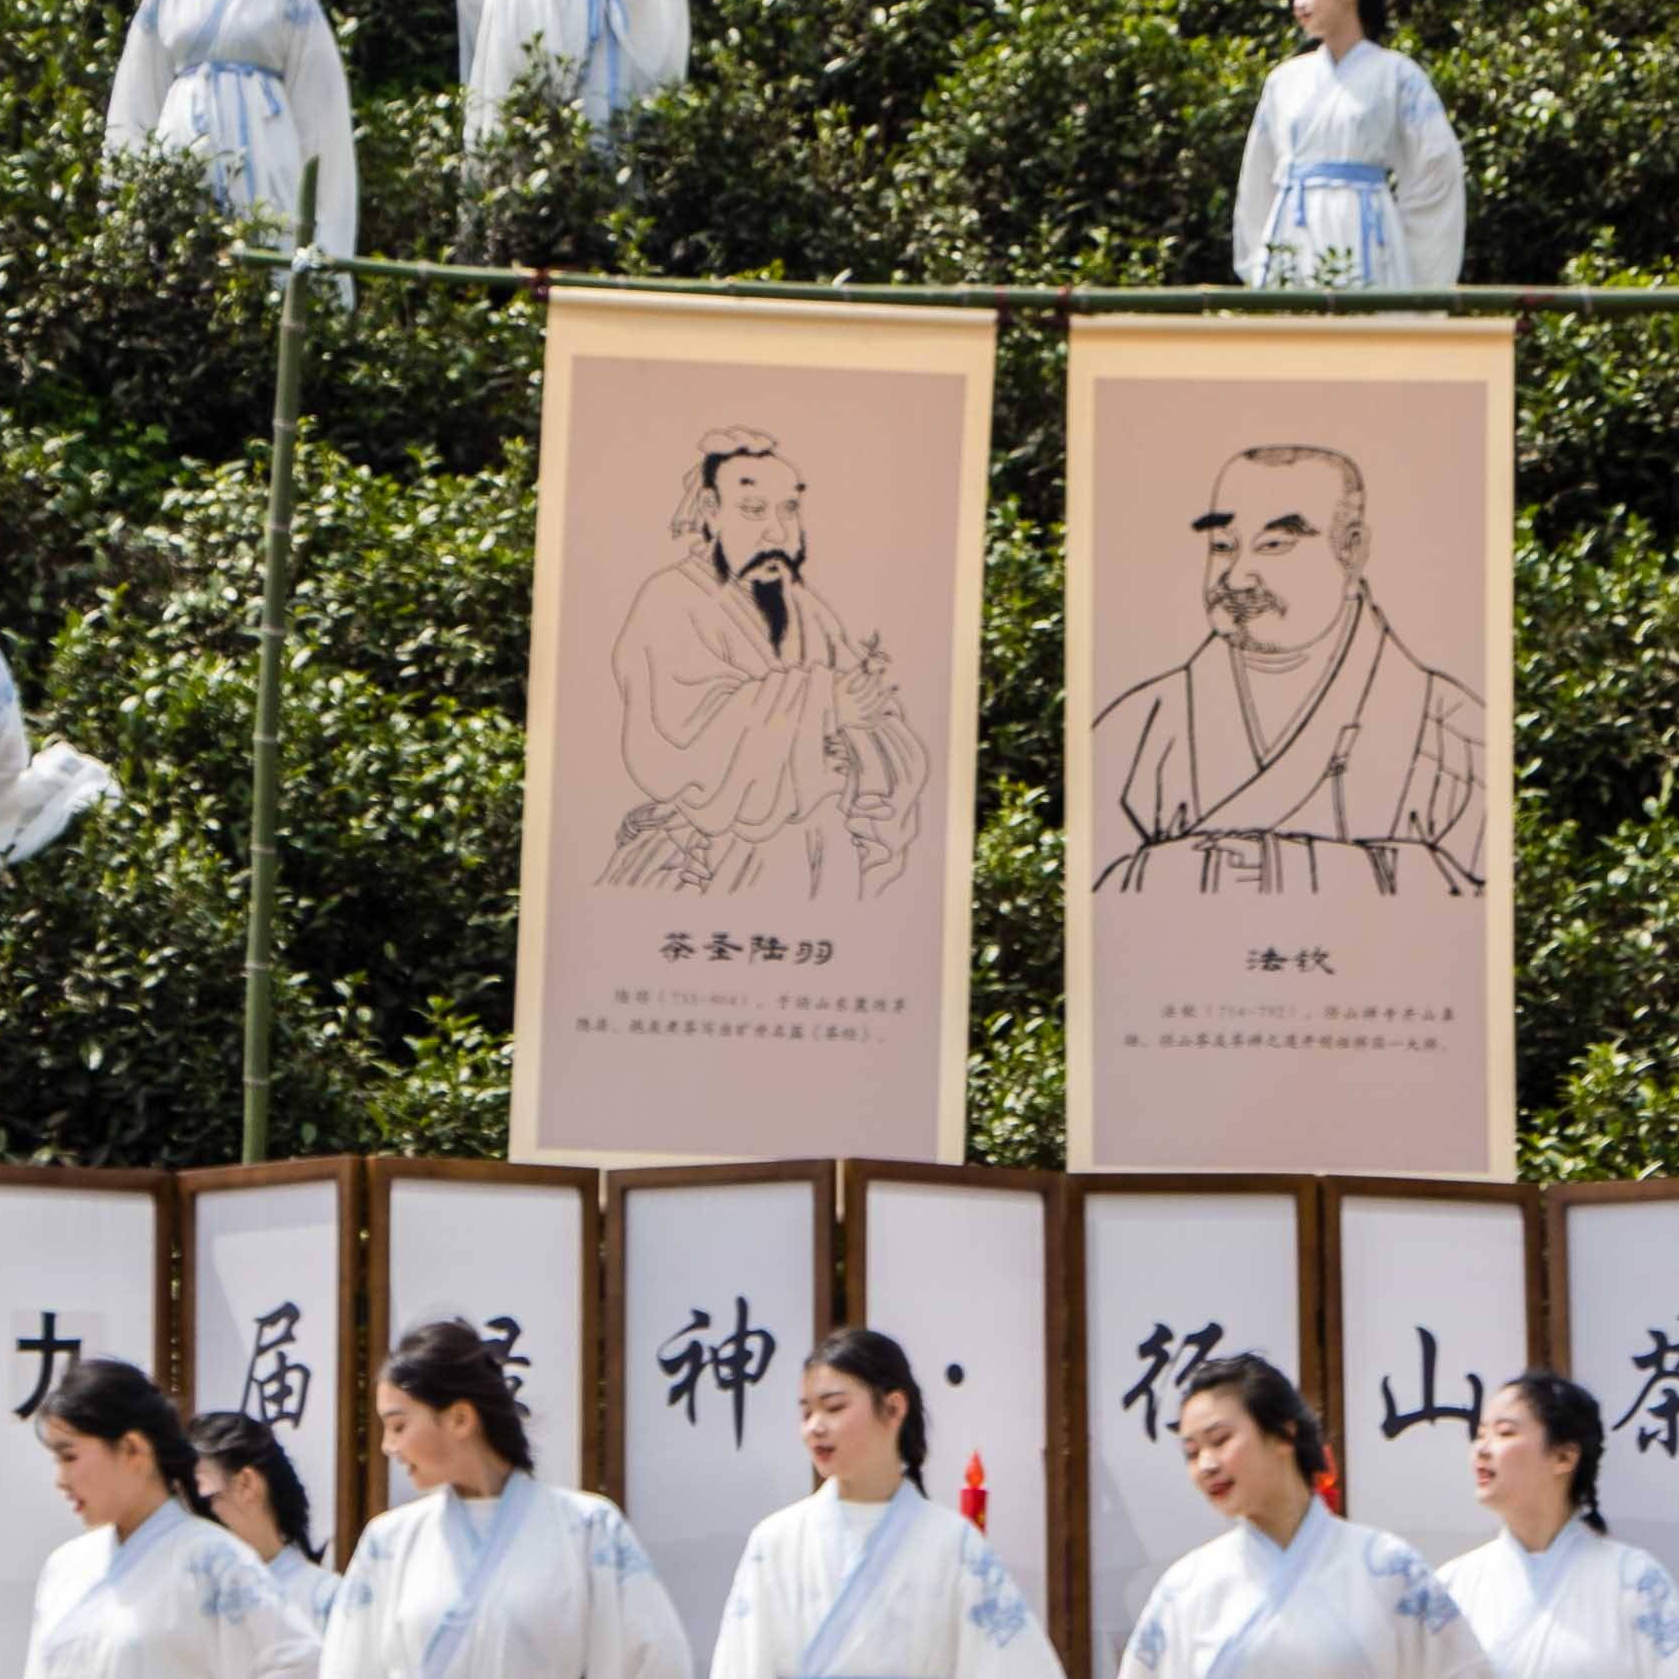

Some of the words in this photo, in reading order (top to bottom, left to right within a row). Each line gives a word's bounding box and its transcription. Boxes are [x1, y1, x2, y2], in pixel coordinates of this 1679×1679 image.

[659, 931, 835, 966] 茶圣陆羽
[1245, 946, 1336, 975] 法钦
